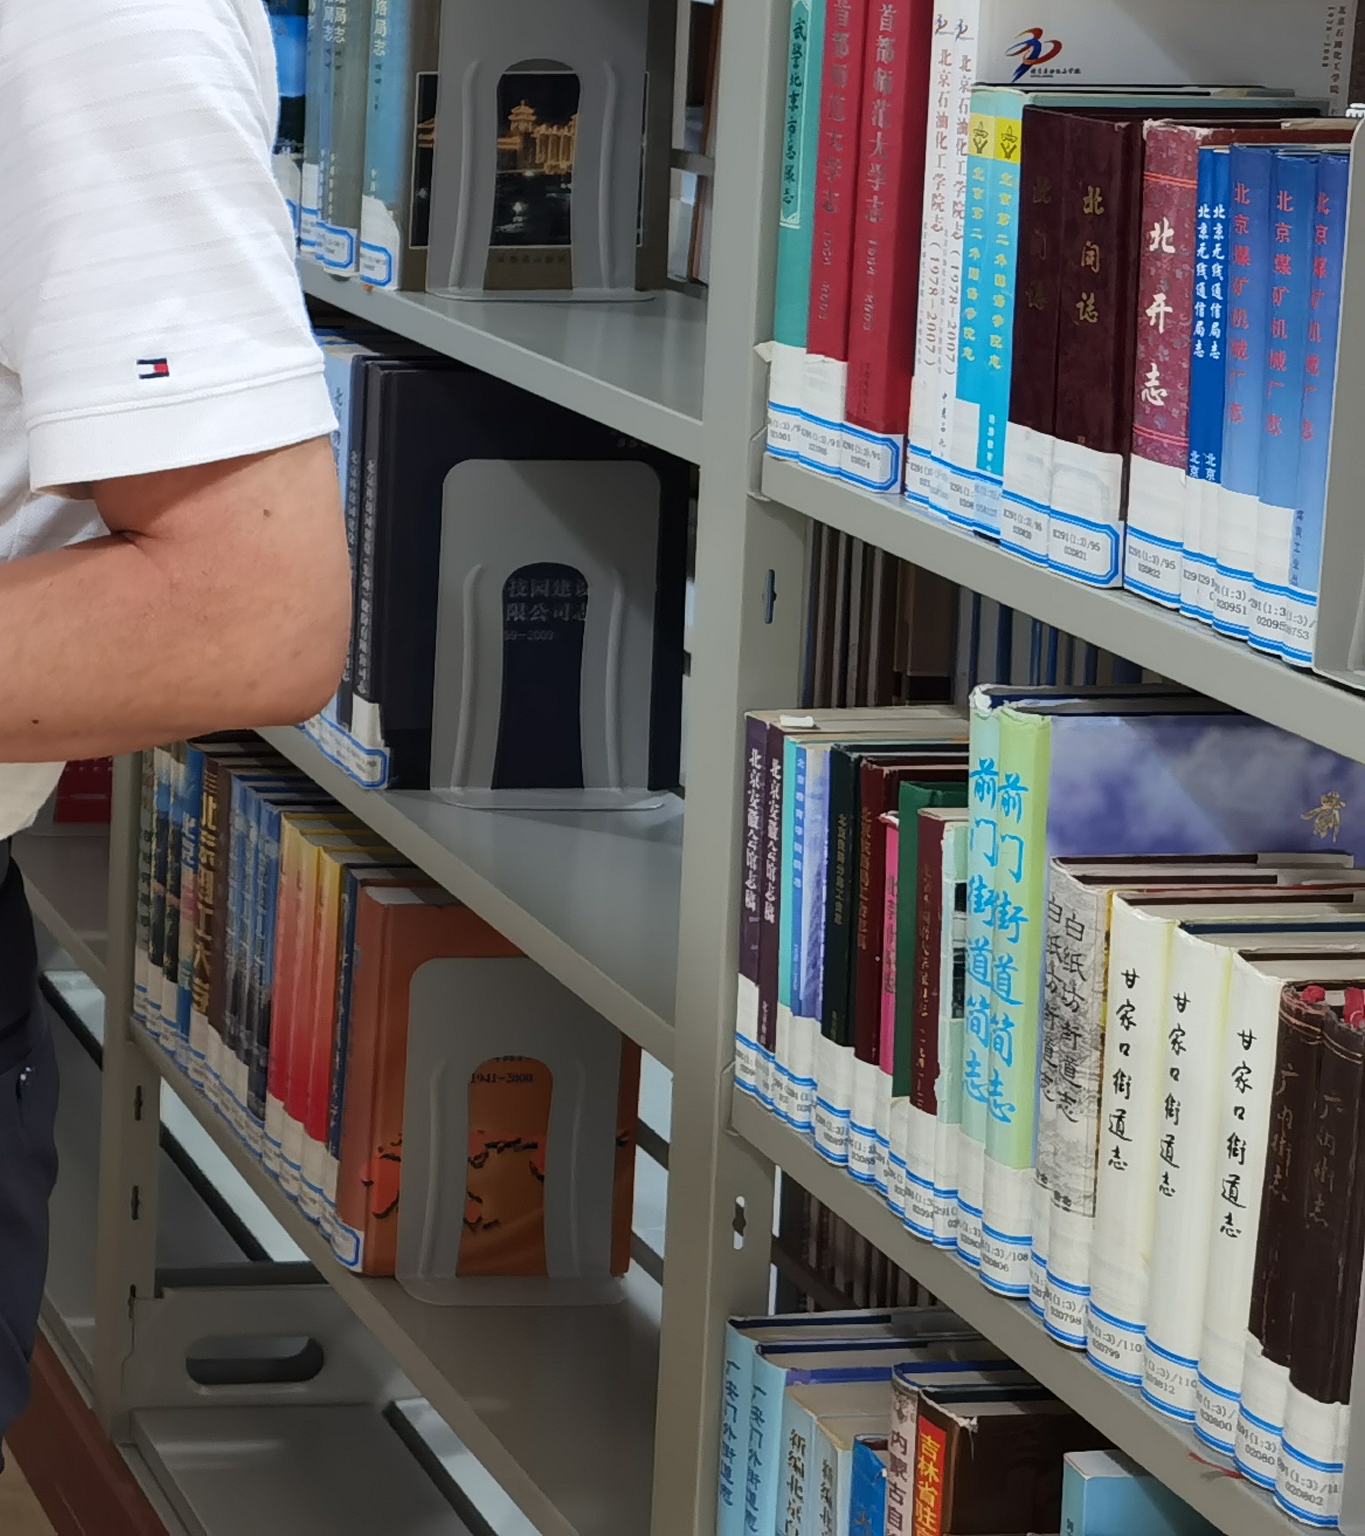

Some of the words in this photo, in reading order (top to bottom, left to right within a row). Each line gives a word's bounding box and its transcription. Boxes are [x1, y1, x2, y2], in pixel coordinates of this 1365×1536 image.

[1141, 216, 1177, 407] 北开志
[963, 757, 1000, 1105] 前门街道简志
[987, 772, 1030, 1124] 前门街道简志
[886, 1430, 909, 1536] 内蒙古自
[915, 1430, 942, 1536] 吉林省驻
